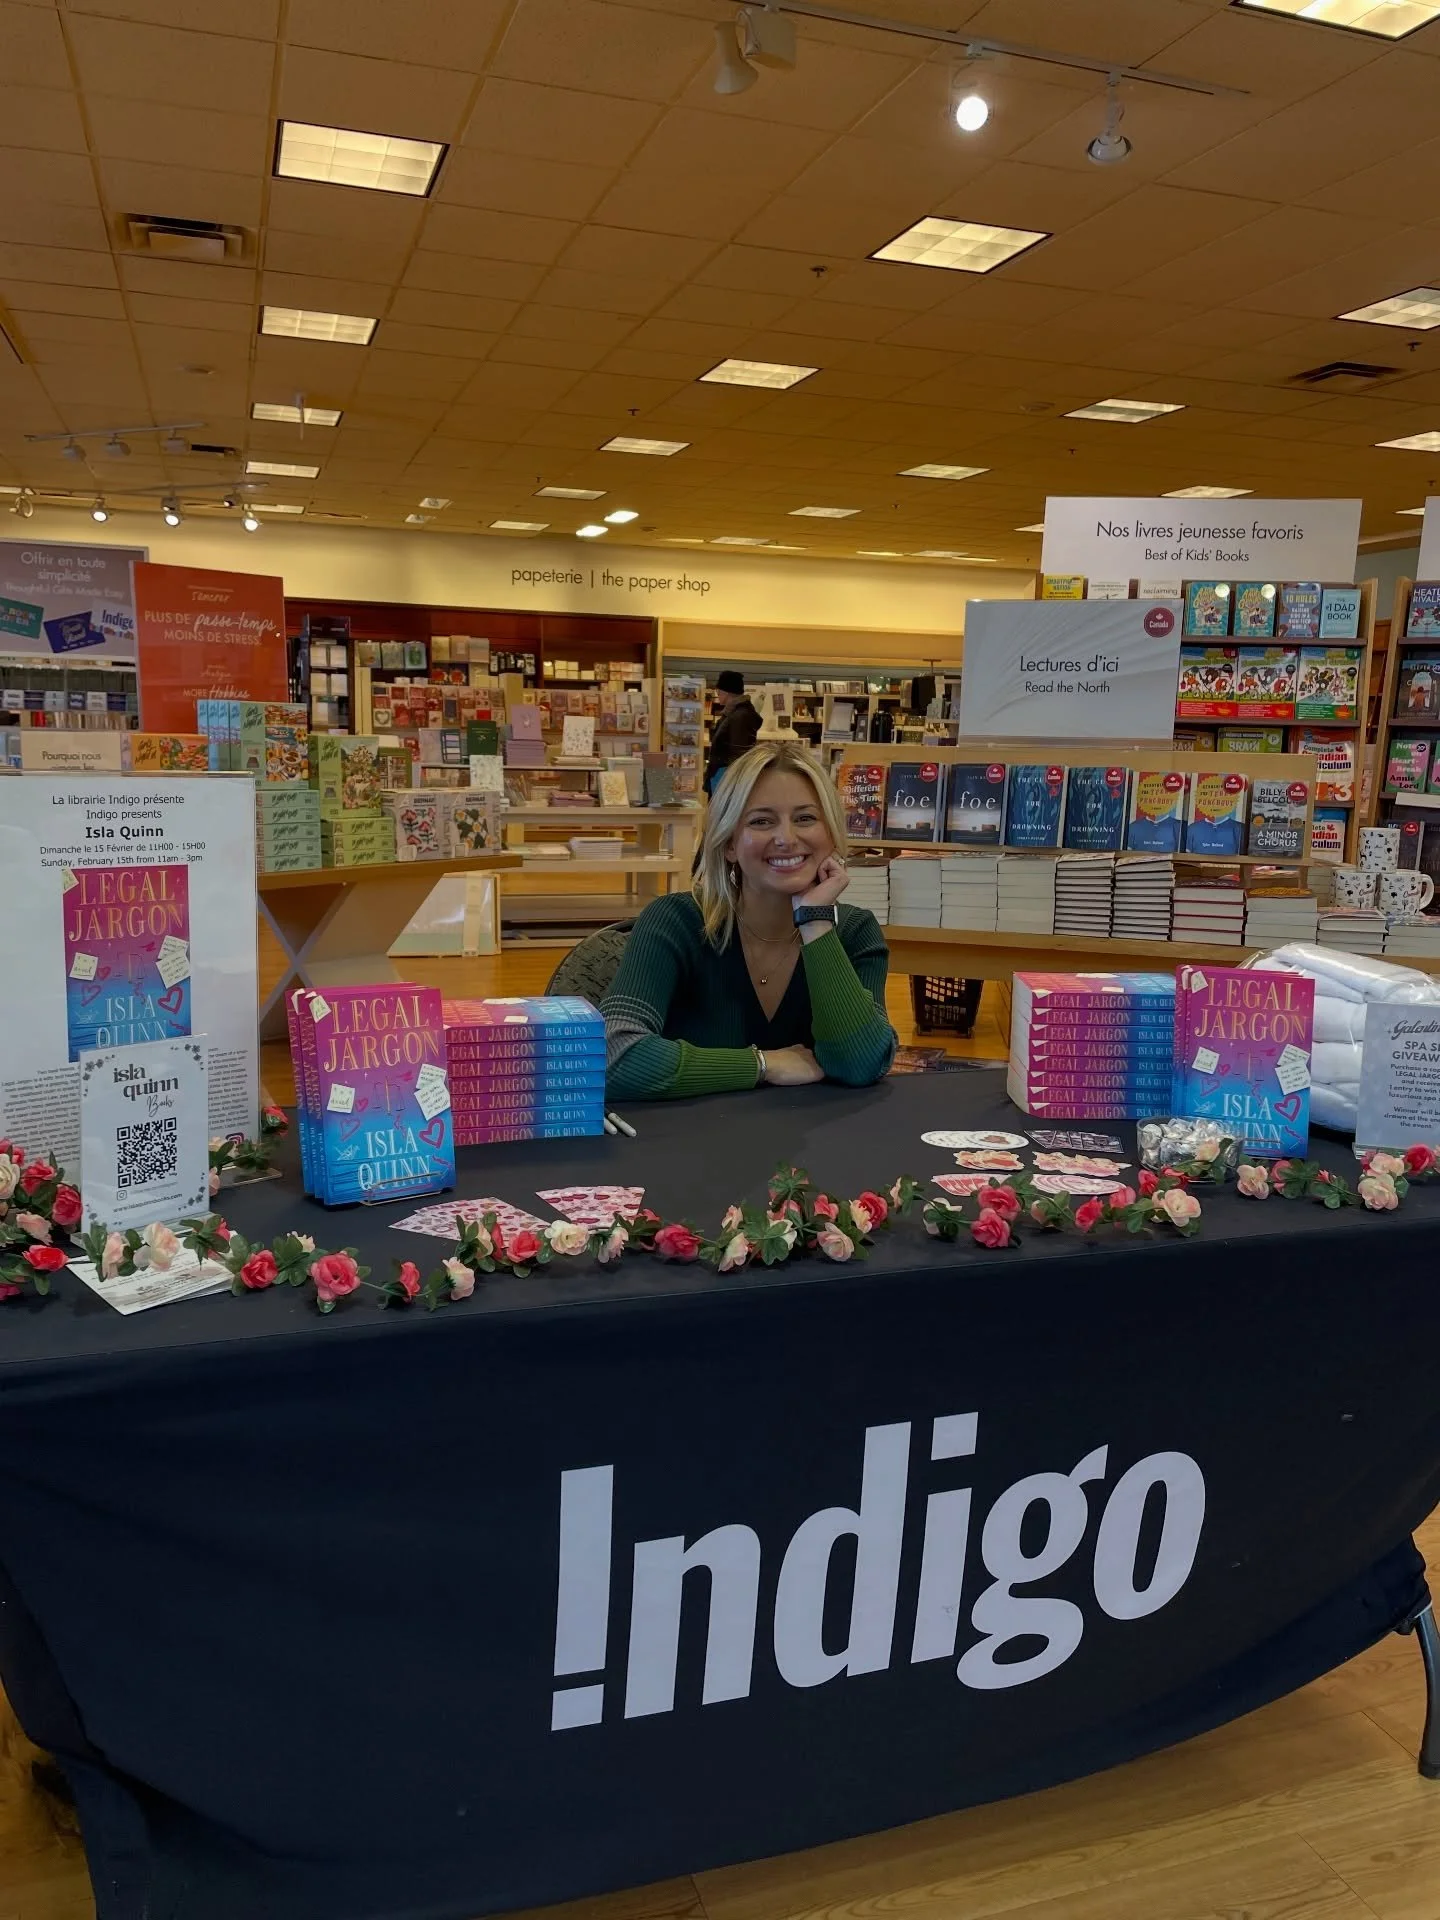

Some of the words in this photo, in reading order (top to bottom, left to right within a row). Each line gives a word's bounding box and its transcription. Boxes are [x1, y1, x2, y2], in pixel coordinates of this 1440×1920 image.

[1096, 521, 1130, 538] Nos
[1135, 521, 1174, 538] livres
[1177, 523, 1246, 543] jeunesse
[1251, 522, 1304, 540] favoris
[20, 551, 53, 565] Offrir
[58, 557, 72, 567] en
[78, 557, 106, 569] toute
[1144, 549, 1168, 561] Best
[1171, 548, 1183, 561] of
[1186, 549, 1213, 562] Kids'
[1215, 550, 1250, 562] Books
[38, 569, 91, 583] simplicité
[511, 569, 583, 587] papeterie
[602, 568, 623, 586] the
[629, 575, 672, 593] paper
[677, 573, 710, 596] shop
[1413, 588, 1440, 596] HEATE
[1335, 603, 1356, 612] DAD
[144, 610, 174, 623] PLUS
[175, 613, 190, 625] DE
[194, 611, 277, 636] passe-temps
[1149, 620, 1169, 630] Canada
[164, 629, 204, 642] MOINS
[207, 631, 221, 643] DE
[224, 633, 262, 646] STRESS.
[1020, 655, 1081, 672] Lectures
[1087, 654, 1119, 672] d'ici
[183, 688, 208, 697] MORE
[1025, 680, 1054, 693] Read
[1057, 680, 1073, 693] the
[1077, 680, 1110, 693] North
[1303, 745, 1334, 753] Complete
[41, 751, 80, 763] Pourquoi
[1318, 762, 1351, 770] iculum
[842, 784, 881, 794] Different
[1334, 782, 1353, 801] 3
[52, 795, 64, 805] La
[68, 795, 106, 805] librairie
[109, 794, 140, 806] Indigo
[143, 794, 185, 805] présente
[842, 795, 858, 804] This
[859, 793, 882, 802] Time
[893, 790, 930, 808] foe
[959, 791, 996, 810] foe
[86, 809, 118, 821] Indigo
[121, 809, 162, 821] presents
[85, 826, 114, 838] Isla
[119, 826, 164, 840] Quinn
[1257, 831, 1264, 839] A
[1265, 831, 1298, 839] MINOR
[40, 845, 82, 854] Dimanche
[84, 845, 91, 853] le
[94, 844, 104, 852] 15
[107, 843, 133, 853] Février
[136, 843, 146, 851] de
[149, 842, 173, 851] 11H00
[182, 841, 206, 850] 15H00
[1257, 839, 1297, 847] CHORUS
[1312, 840, 1341, 849] culum
[41, 858, 75, 867] Sunday,
[77, 856, 113, 866] February
[116, 856, 134, 864] 15th
[136, 855, 155, 863] from
[157, 855, 179, 863] 11am
[186, 854, 203, 862] 3pm
[79, 870, 176, 906] LEGAL
[69, 904, 184, 942] JARGON
[1206, 977, 1299, 1011] LEGAL
[105, 994, 156, 1023] ISLA
[1047, 995, 1081, 1008] LEGAL
[1088, 995, 1131, 1008] JARGON
[1142, 999, 1158, 1007] ISLA
[329, 996, 430, 1034] LEGAL
[1046, 1011, 1082, 1024] LEGAL
[1087, 1011, 1131, 1024] JARGON
[1140, 1015, 1156, 1023] ISLA
[1194, 1009, 1307, 1043] JARGON
[96, 1020, 167, 1048] QUINN
[489, 1026, 535, 1041] JARGON
[545, 1027, 561, 1037] ISLA
[564, 1026, 587, 1036] QUINN
[1043, 1028, 1079, 1040] LEGAL
[1085, 1028, 1128, 1041] JARGON
[324, 1030, 440, 1073] JARGON
[489, 1043, 535, 1058] JARGON
[546, 1044, 561, 1054] ISLA
[564, 1043, 588, 1053] QUINN
[1043, 1044, 1079, 1056] LEGAL
[1084, 1044, 1128, 1057] JARGON
[1404, 1040, 1427, 1050] SPA
[1392, 1050, 1440, 1062] GIVEAW
[113, 1064, 146, 1083] isla
[490, 1060, 536, 1075] JARGON
[546, 1061, 562, 1070] ISLA
[564, 1059, 588, 1069] QUINN
[123, 1077, 179, 1102] quinn
[489, 1077, 535, 1092] JARGON
[147, 1094, 175, 1118] Books
[489, 1094, 535, 1109] JARGON
[1223, 1093, 1272, 1120] ISLA
[1384, 1112, 1407, 1120] drawn
[1393, 1106, 1418, 1114] Winner
[364, 1126, 419, 1159] ISLA
[358, 1155, 432, 1191] QUINN
